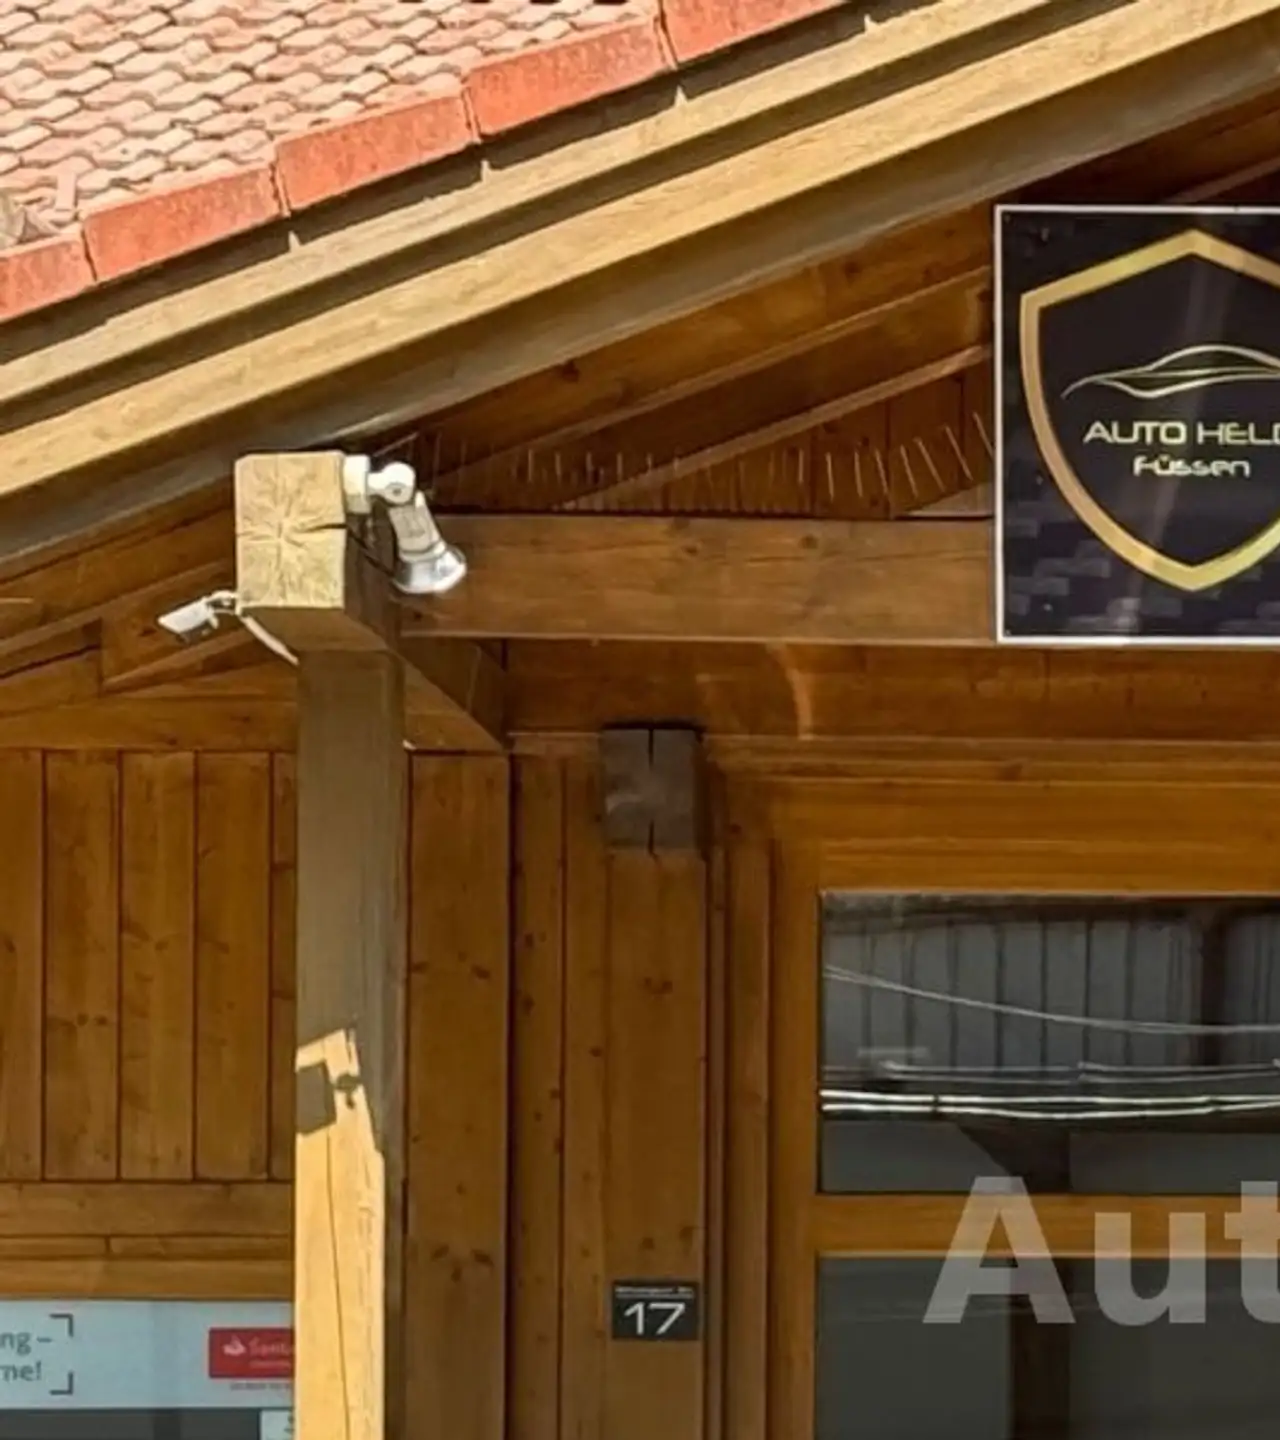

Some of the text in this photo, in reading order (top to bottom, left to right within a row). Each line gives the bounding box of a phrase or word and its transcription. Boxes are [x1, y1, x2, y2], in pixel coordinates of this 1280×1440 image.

[1083, 419, 1187, 446] AUTO
[1132, 453, 1251, 479] Füssen
[623, 1301, 686, 1335] 17
